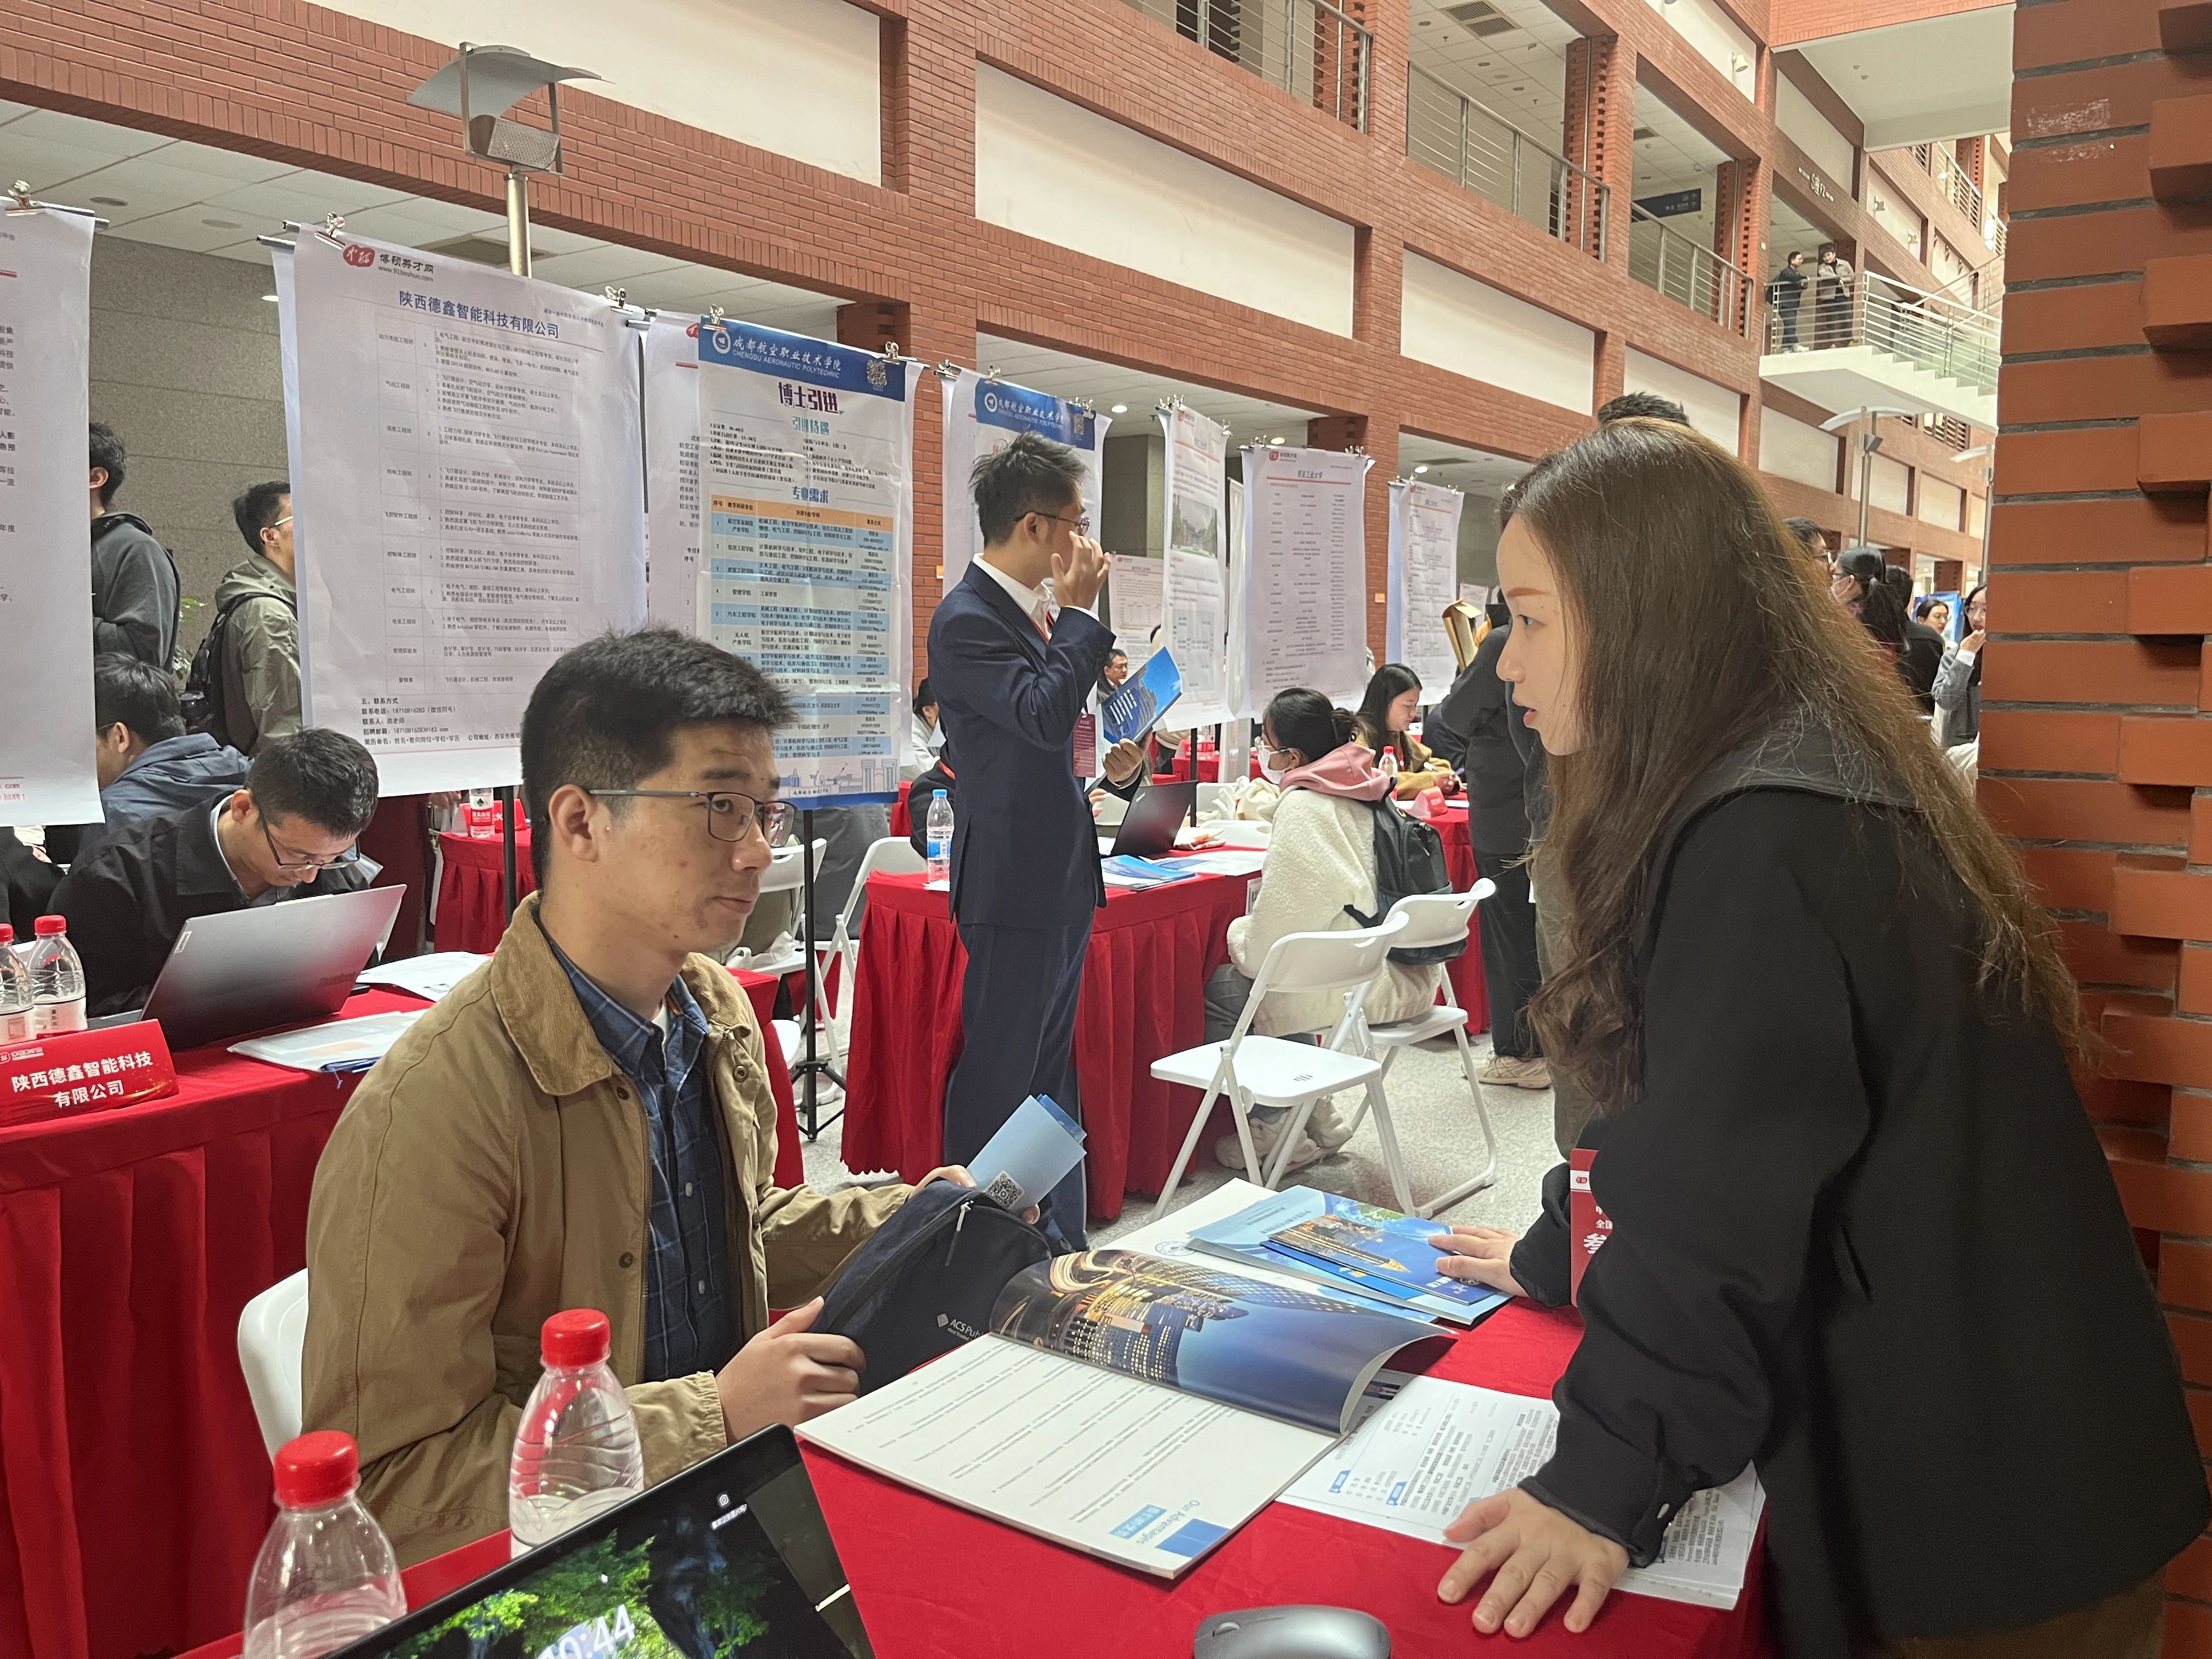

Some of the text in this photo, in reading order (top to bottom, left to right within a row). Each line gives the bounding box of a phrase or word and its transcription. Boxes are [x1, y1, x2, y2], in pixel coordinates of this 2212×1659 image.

[399, 290, 559, 339] 陕西德鑫智能科技有限公司
[732, 335, 841, 371] 成都航空职业技术学院
[732, 349, 840, 379] CHENGDU AERONAUTIC POLYTECHNIC
[778, 382, 839, 414] 博士引进
[792, 486, 829, 504] 专业需求
[11, 1051, 153, 1093] 陕西德鑫智能科技
[54, 1080, 125, 1108] 有限公司
[950, 1319, 967, 1332] ACS
[1181, 1499, 1200, 1513] Our
[1136, 1511, 1186, 1544] Advantages
